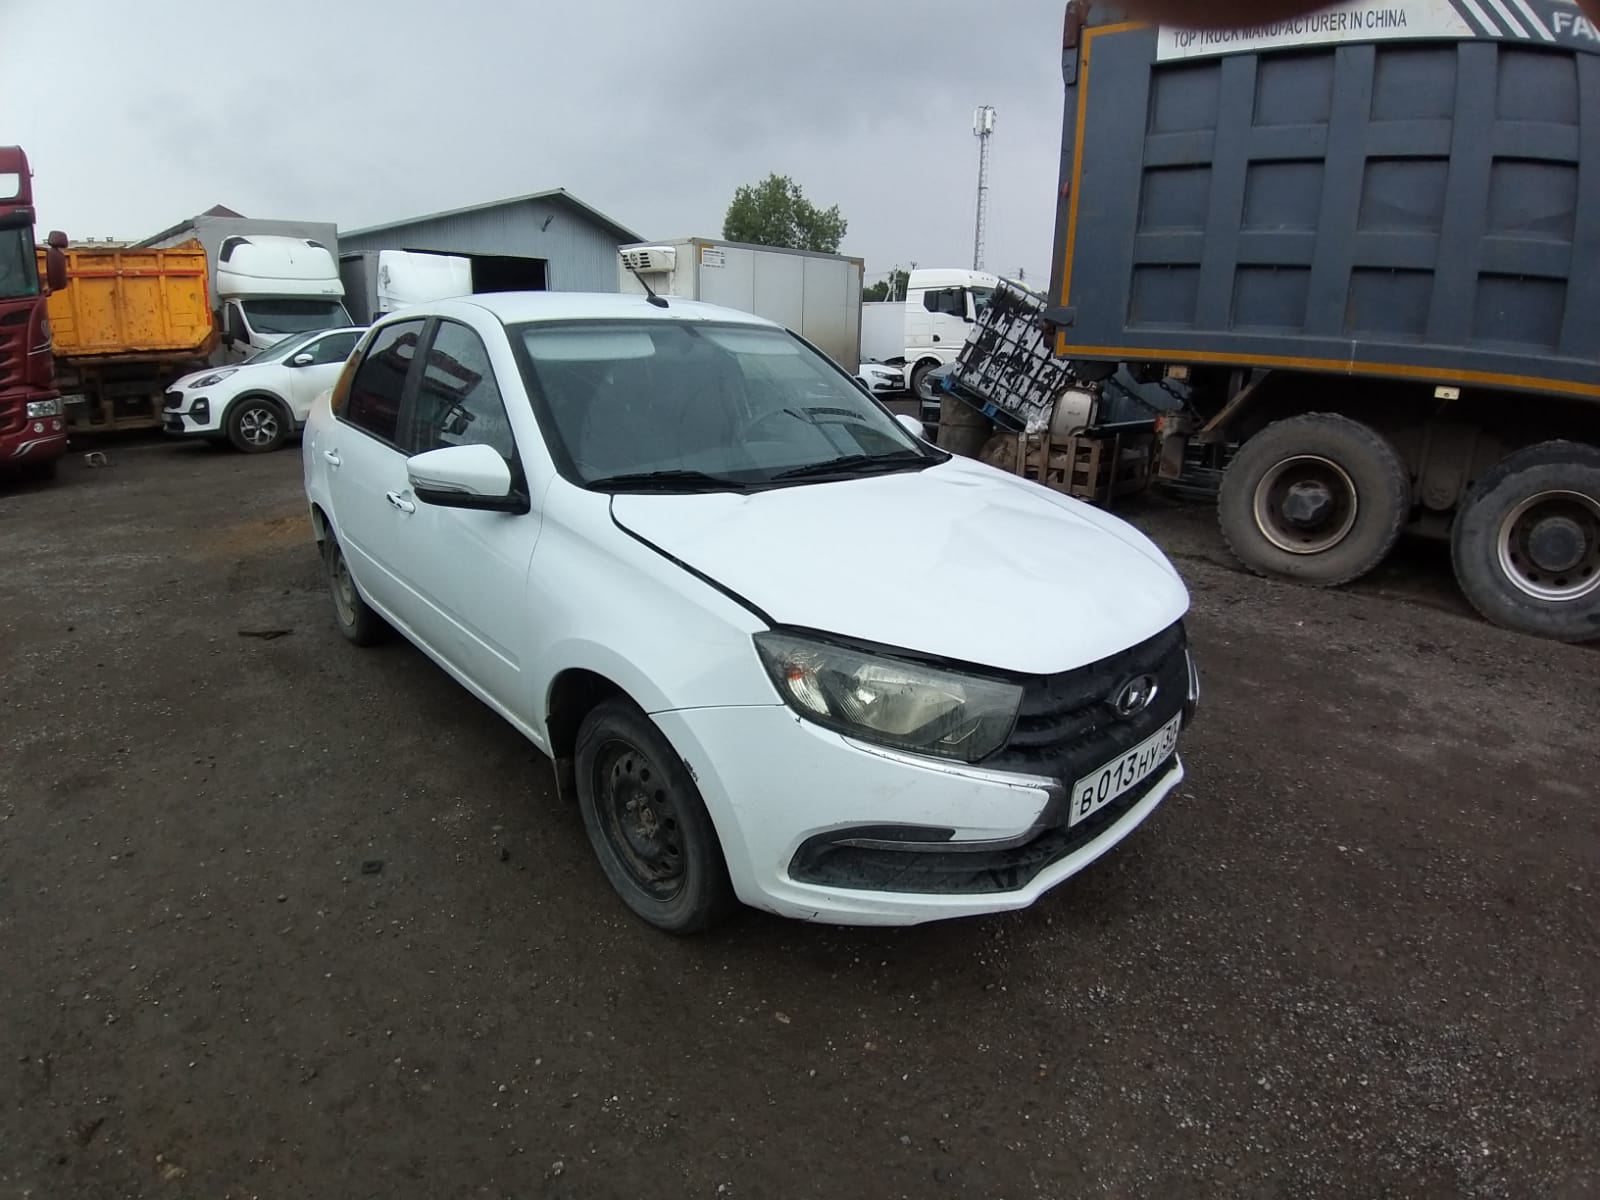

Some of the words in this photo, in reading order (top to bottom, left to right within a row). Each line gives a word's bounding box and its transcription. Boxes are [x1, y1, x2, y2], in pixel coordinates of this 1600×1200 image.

[1174, 31, 1196, 48] TOP
[1200, 29, 1239, 45] TRUCK
[1350, 10, 1362, 30] IN
[1366, 8, 1407, 28] CHINA
[1553, 11, 1600, 41] FA
